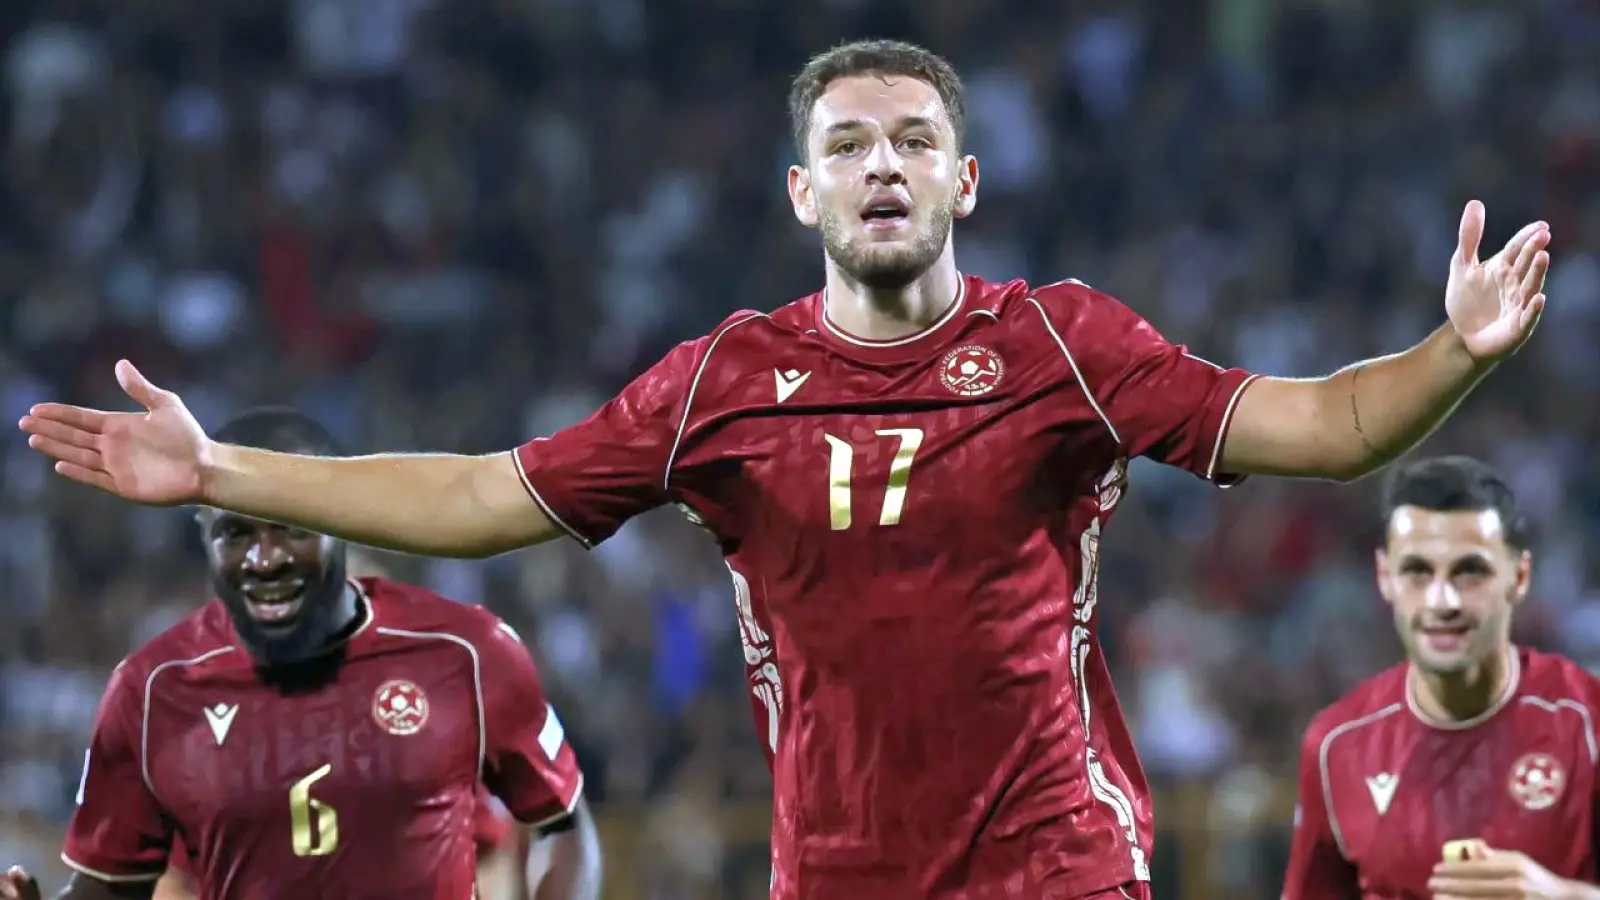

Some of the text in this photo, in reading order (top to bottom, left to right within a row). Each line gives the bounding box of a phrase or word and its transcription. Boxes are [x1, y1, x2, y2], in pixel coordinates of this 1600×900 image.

[941, 345, 987, 365] FEDERATION
[987, 350, 998, 358] OF
[939, 365, 960, 394] FOOTBALL
[824, 428, 924, 530] 17
[289, 763, 338, 857] 6
